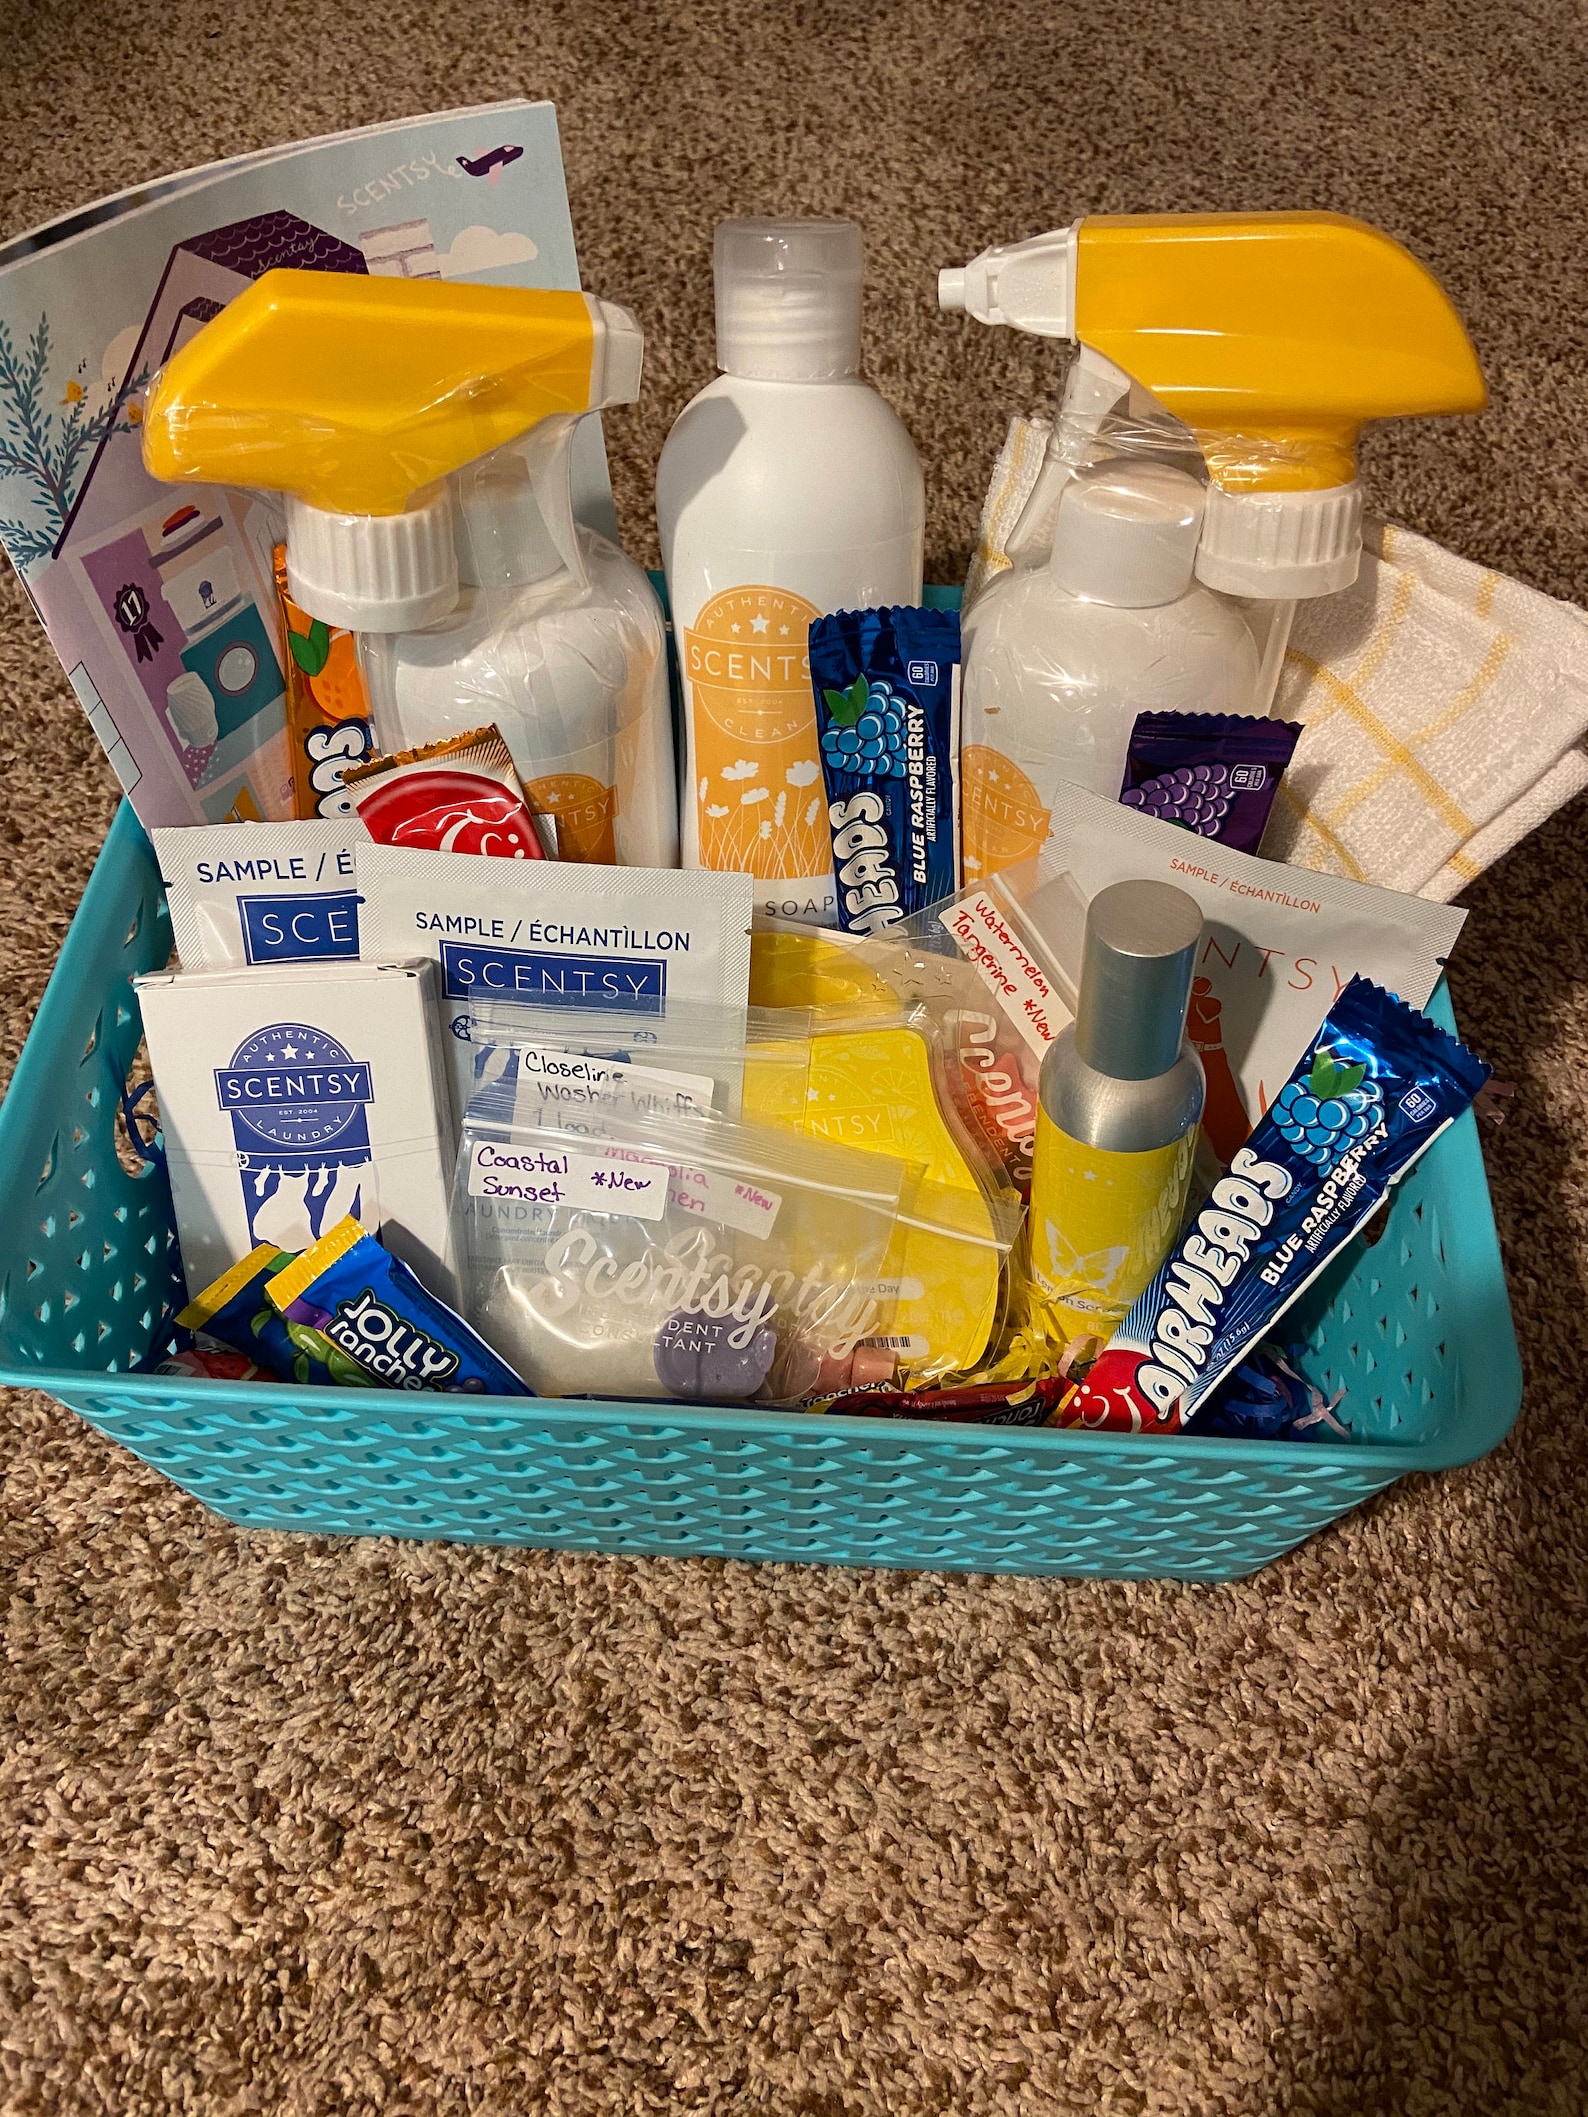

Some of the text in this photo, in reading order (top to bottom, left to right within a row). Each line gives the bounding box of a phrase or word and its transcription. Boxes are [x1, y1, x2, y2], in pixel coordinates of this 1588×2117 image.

[337, 151, 455, 214] SCENTSY
[706, 596, 808, 628] AUTHENTI
[691, 644, 812, 681] SCENTS
[912, 666, 924, 679] 60
[724, 717, 798, 738] CLEAN
[1234, 770, 1249, 783] 60
[907, 704, 927, 884] BLUE RASPBERRY
[924, 756, 938, 842] ARTIFICIALLY FLAVORED
[197, 857, 307, 883] SAMPLE
[829, 792, 904, 937] HEADS
[1170, 858, 1220, 885] SAMPLE
[765, 895, 835, 916] SOAP
[415, 911, 504, 938] SAMPLE
[952, 909, 1018, 997] Tangerine
[457, 958, 649, 1001] SCENTSY
[1202, 936, 1350, 1003] NTSY
[242, 1030, 339, 1063] AUTHENTIC
[227, 1072, 361, 1099] SCENTSY
[1405, 1092, 1421, 1109] 60
[256, 1115, 342, 1141] LAUNDRY
[477, 1145, 569, 1174] Coastal
[482, 1176, 566, 1203] Sunset
[1260, 1121, 1390, 1287] BLUE RASPBERRY
[1285, 1181, 1303, 1204] CANDY
[1304, 1175, 1367, 1254] ARTIFICIALLY FLAVORED
[528, 1227, 779, 1349] Scentsy
[1137, 1147, 1293, 1421] AIRHEADS
[344, 1295, 452, 1379] JOLLY
